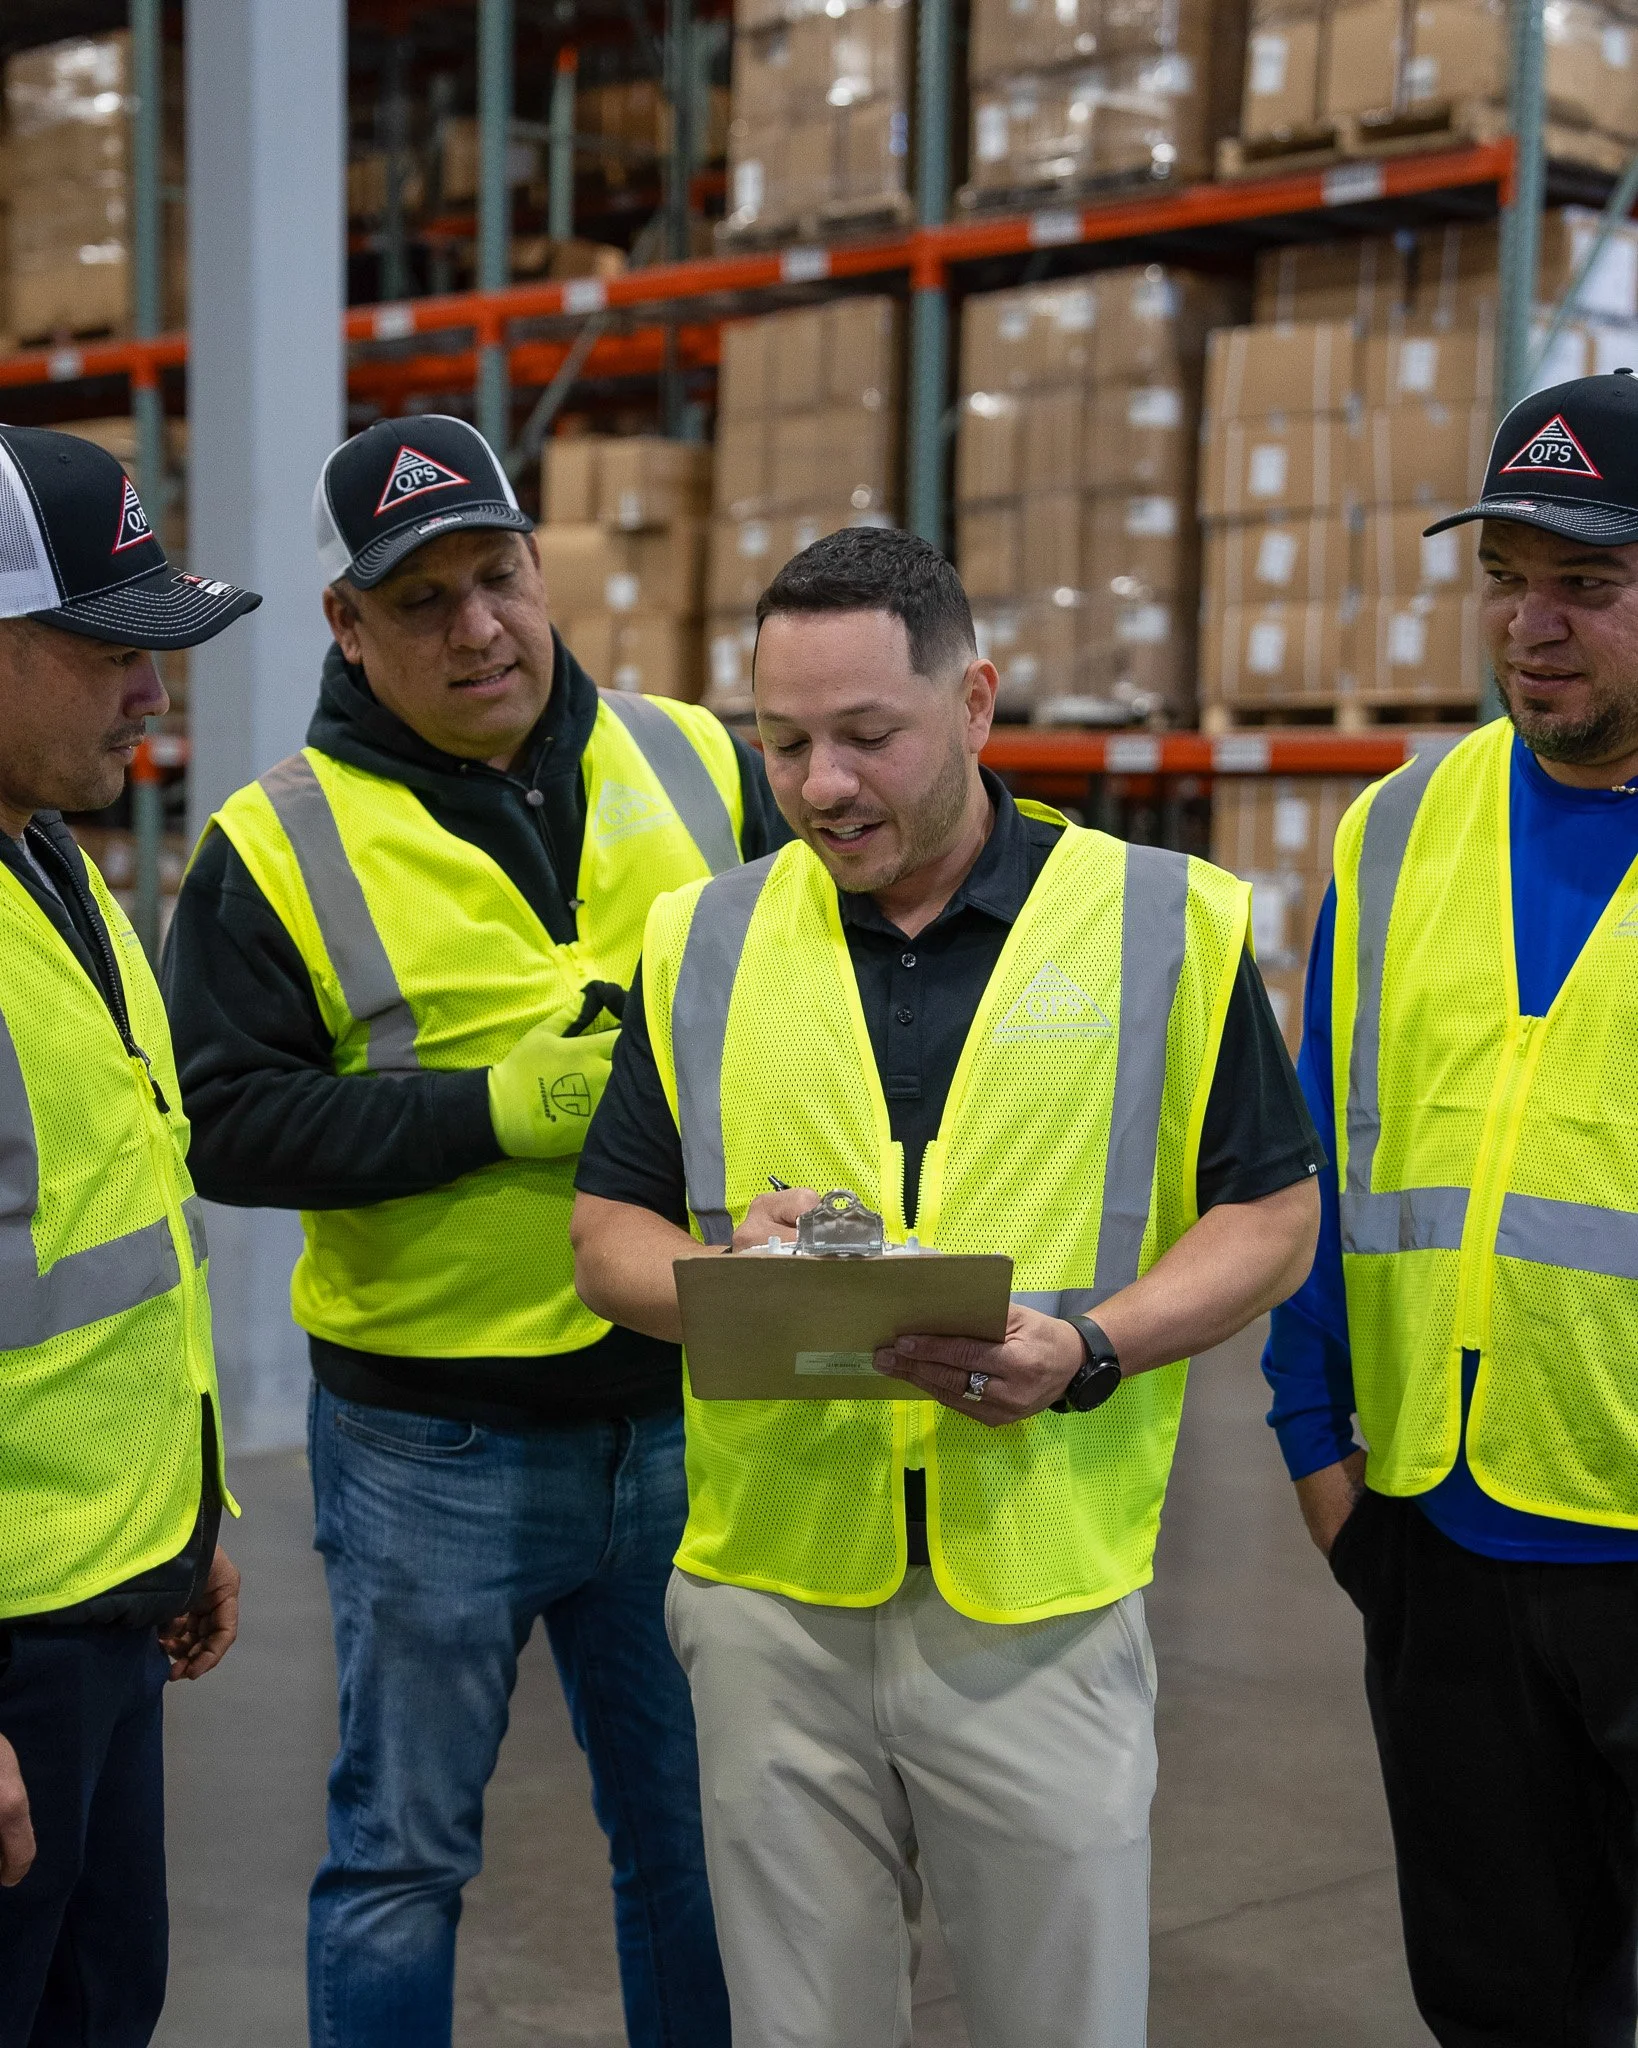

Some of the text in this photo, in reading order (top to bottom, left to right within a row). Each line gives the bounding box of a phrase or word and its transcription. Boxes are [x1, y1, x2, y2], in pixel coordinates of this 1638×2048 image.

[1529, 443, 1572, 464] QPS
[395, 465, 438, 494] QPS
[1025, 995, 1083, 1020] QPS
